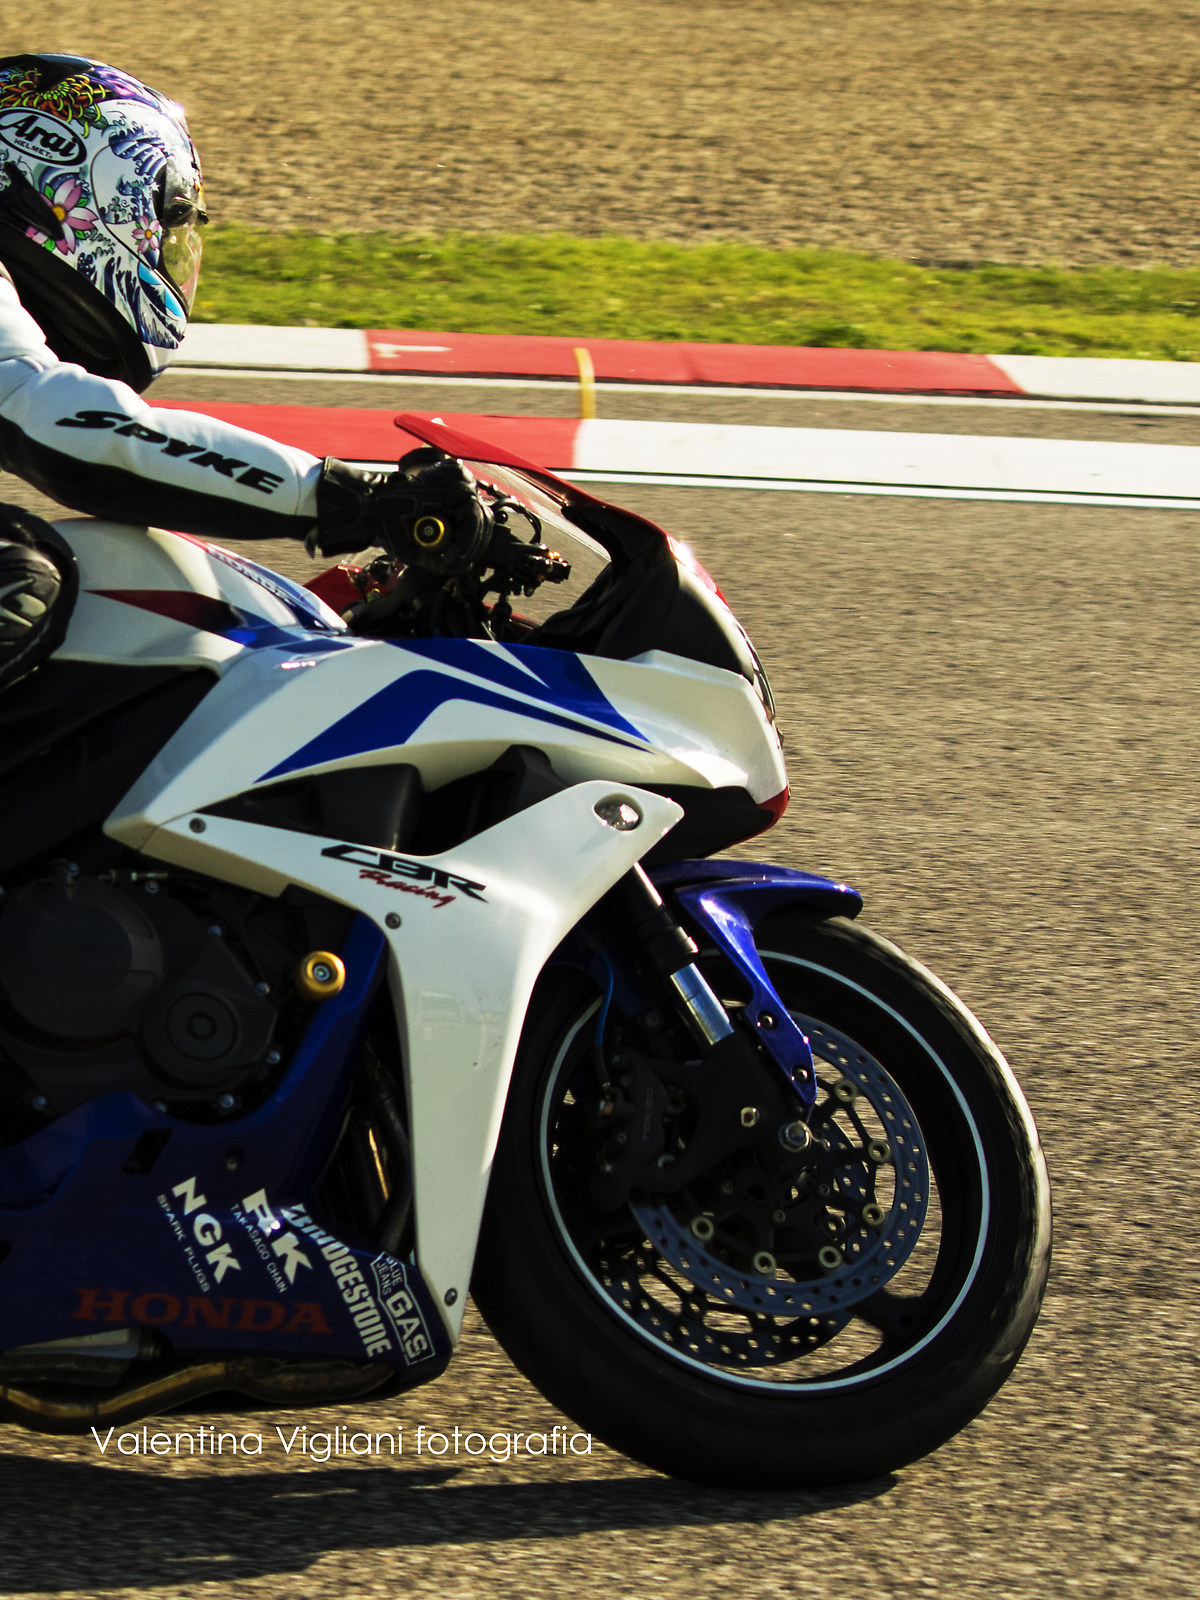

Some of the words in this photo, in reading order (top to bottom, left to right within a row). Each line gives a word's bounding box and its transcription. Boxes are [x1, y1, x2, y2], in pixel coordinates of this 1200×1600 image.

[55, 411, 285, 494] SPYKE
[320, 844, 490, 904] CBR
[358, 869, 457, 909] Racing
[157, 1194, 185, 1242] SPARK
[183, 1246, 210, 1292] PLUGS
[172, 1176, 241, 1284] NGK
[229, 1203, 270, 1260] TAKASAGO
[267, 1261, 288, 1294] CHAIN
[242, 1188, 313, 1285] RK
[72, 1288, 333, 1335] HONDA
[280, 1203, 392, 1358] BRIDGESTONE
[375, 1262, 393, 1296] JEANS
[389, 1291, 428, 1359] GAS
